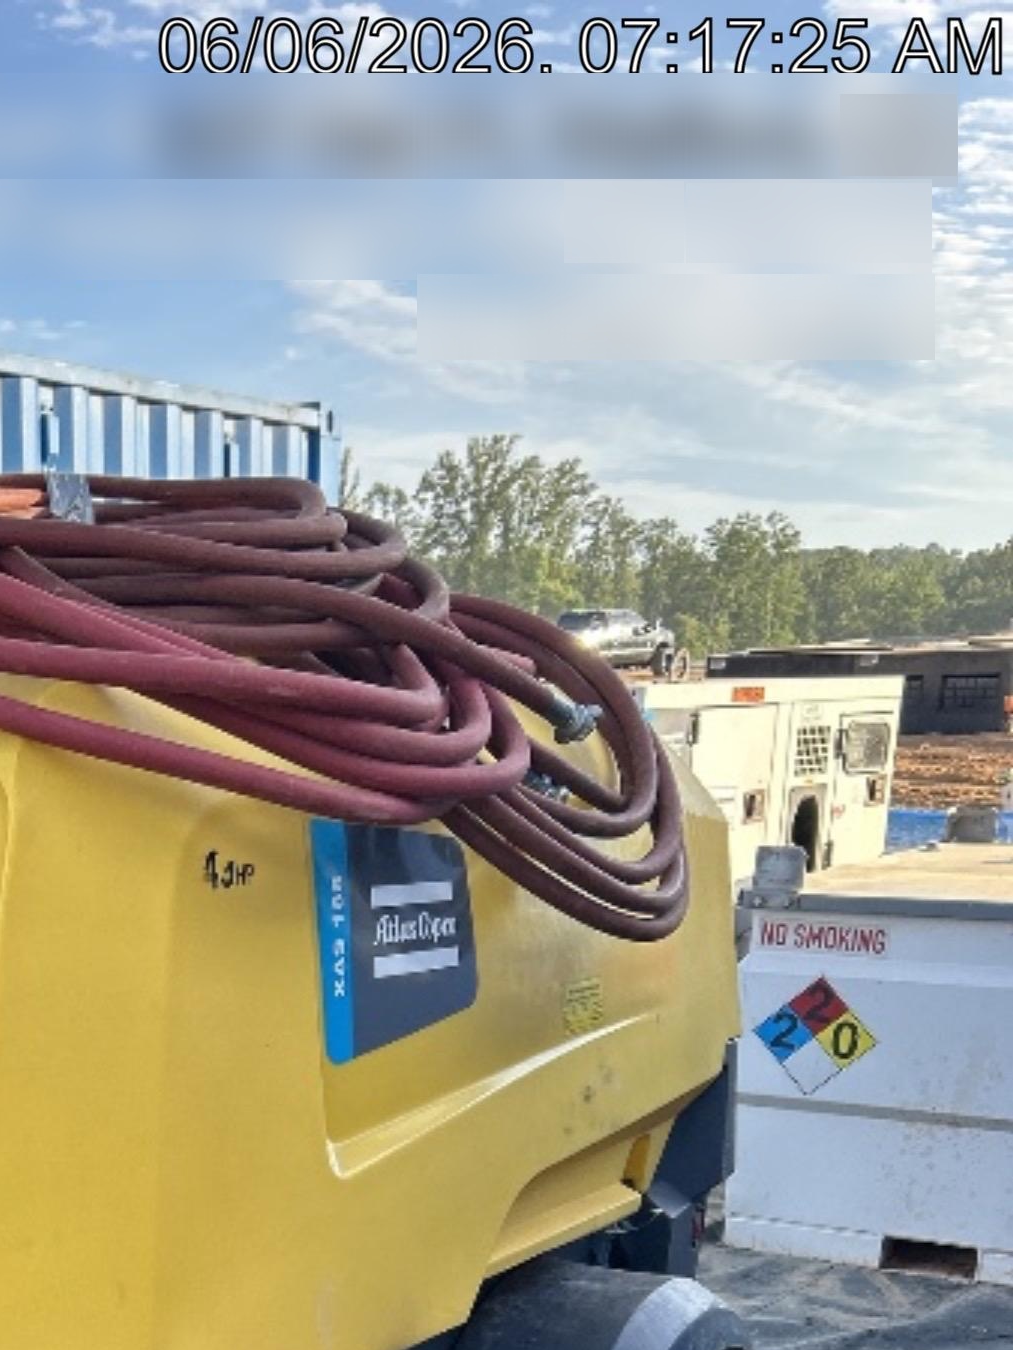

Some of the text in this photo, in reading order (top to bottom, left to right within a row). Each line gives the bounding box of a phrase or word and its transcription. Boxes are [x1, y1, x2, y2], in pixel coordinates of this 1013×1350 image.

[373, 914, 417, 946] Atlas
[761, 921, 886, 955] NO SMOKING
[805, 984, 833, 1024] 2
[770, 1013, 859, 1060] 2 0
